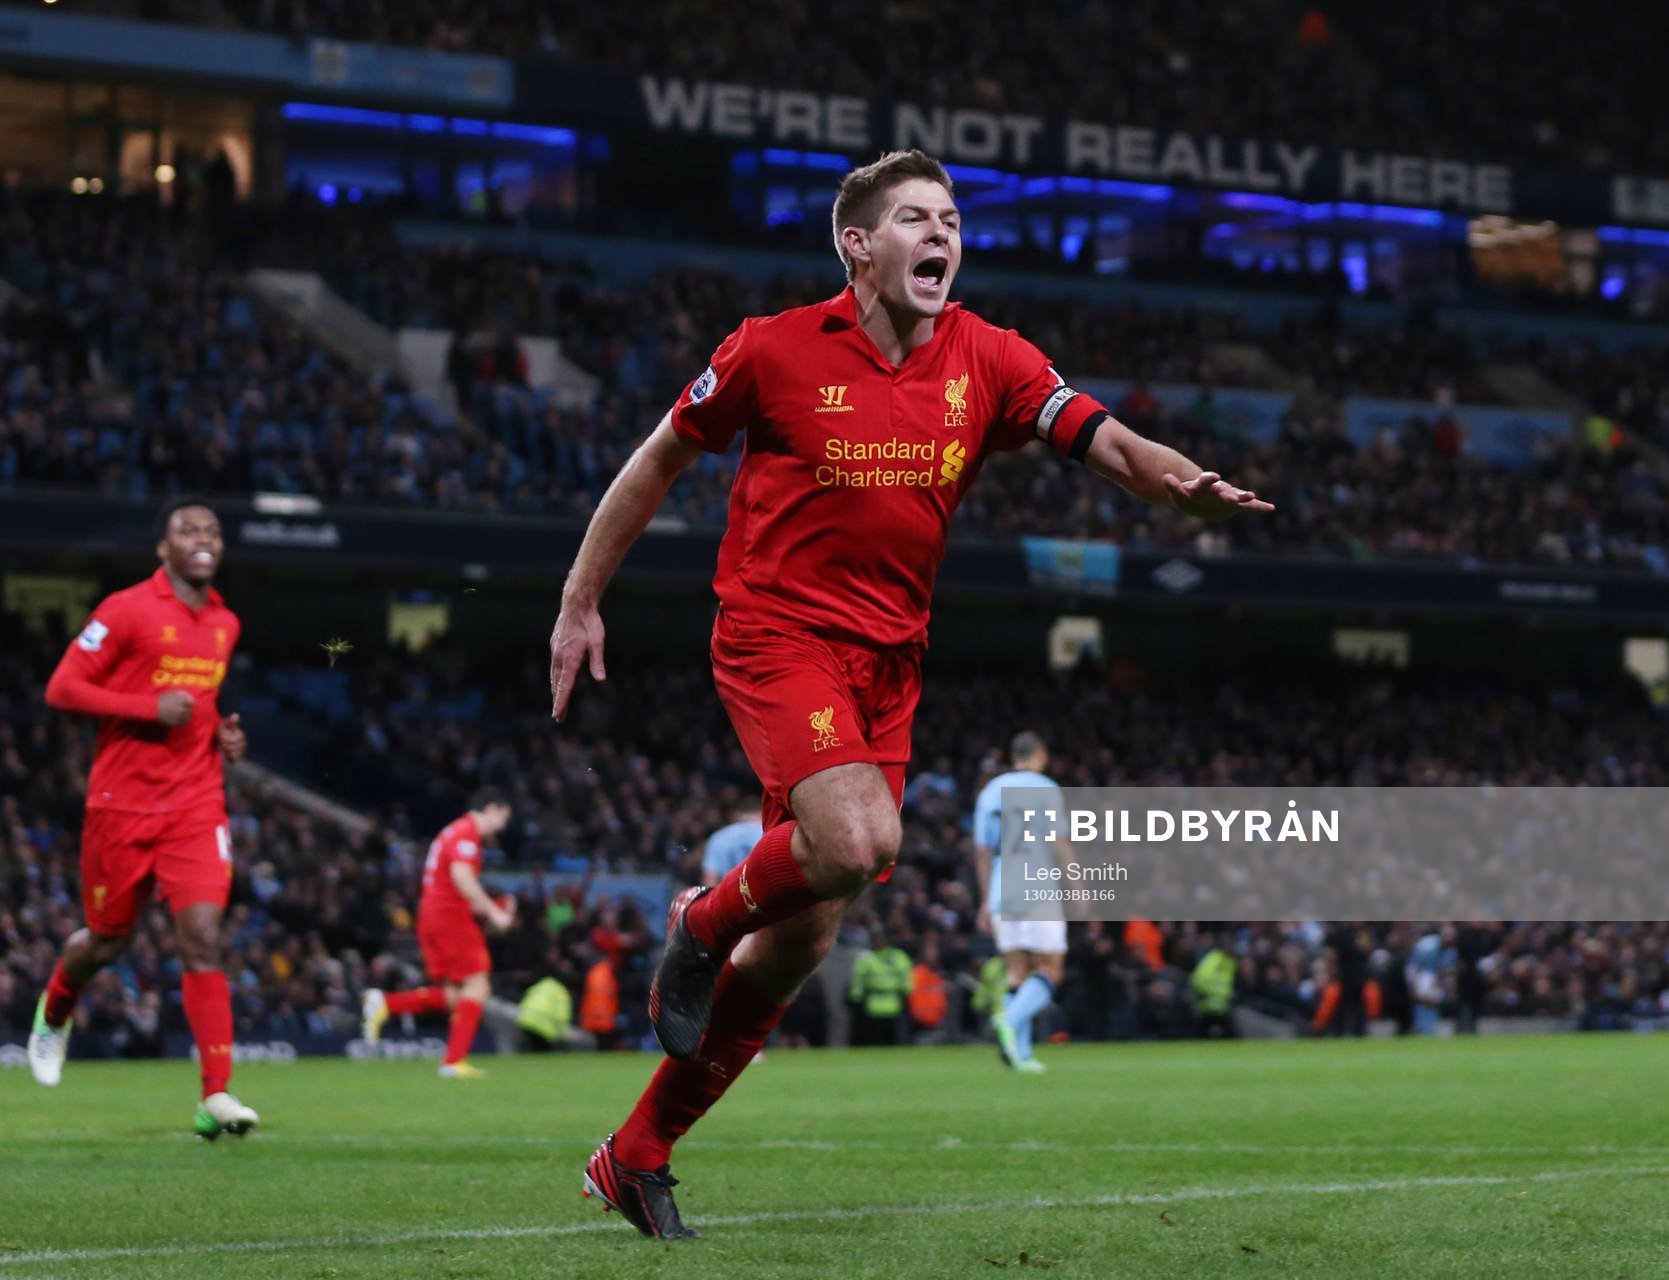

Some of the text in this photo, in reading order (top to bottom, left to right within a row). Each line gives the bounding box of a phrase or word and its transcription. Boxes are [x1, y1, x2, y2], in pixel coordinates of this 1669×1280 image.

[640, 74, 1512, 211] WE'RE NOT REALLY HERE
[825, 437, 936, 461] Standard
[815, 465, 934, 487] Chartered
